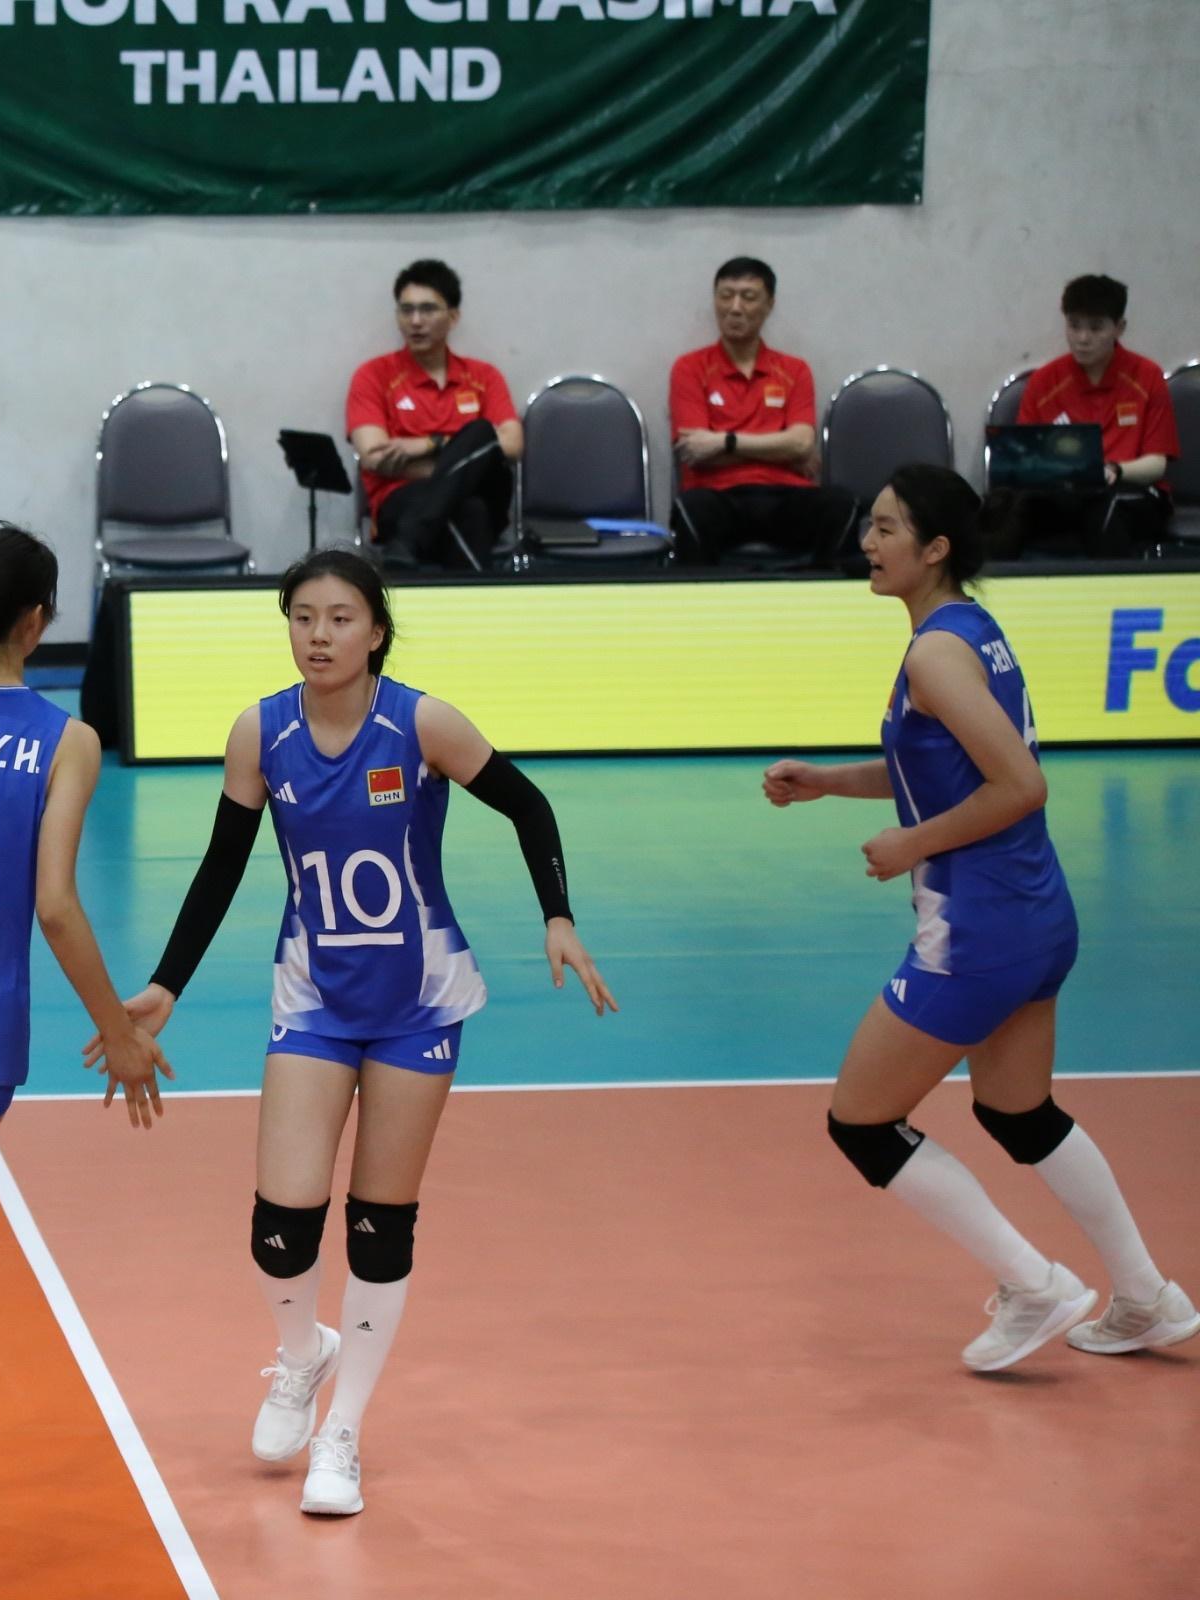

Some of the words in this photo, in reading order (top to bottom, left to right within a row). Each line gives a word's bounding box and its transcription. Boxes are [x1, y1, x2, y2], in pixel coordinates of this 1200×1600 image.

[120, 47, 501, 104] THAILAND
[374, 791, 401, 803] CHN
[301, 849, 402, 930] 10
